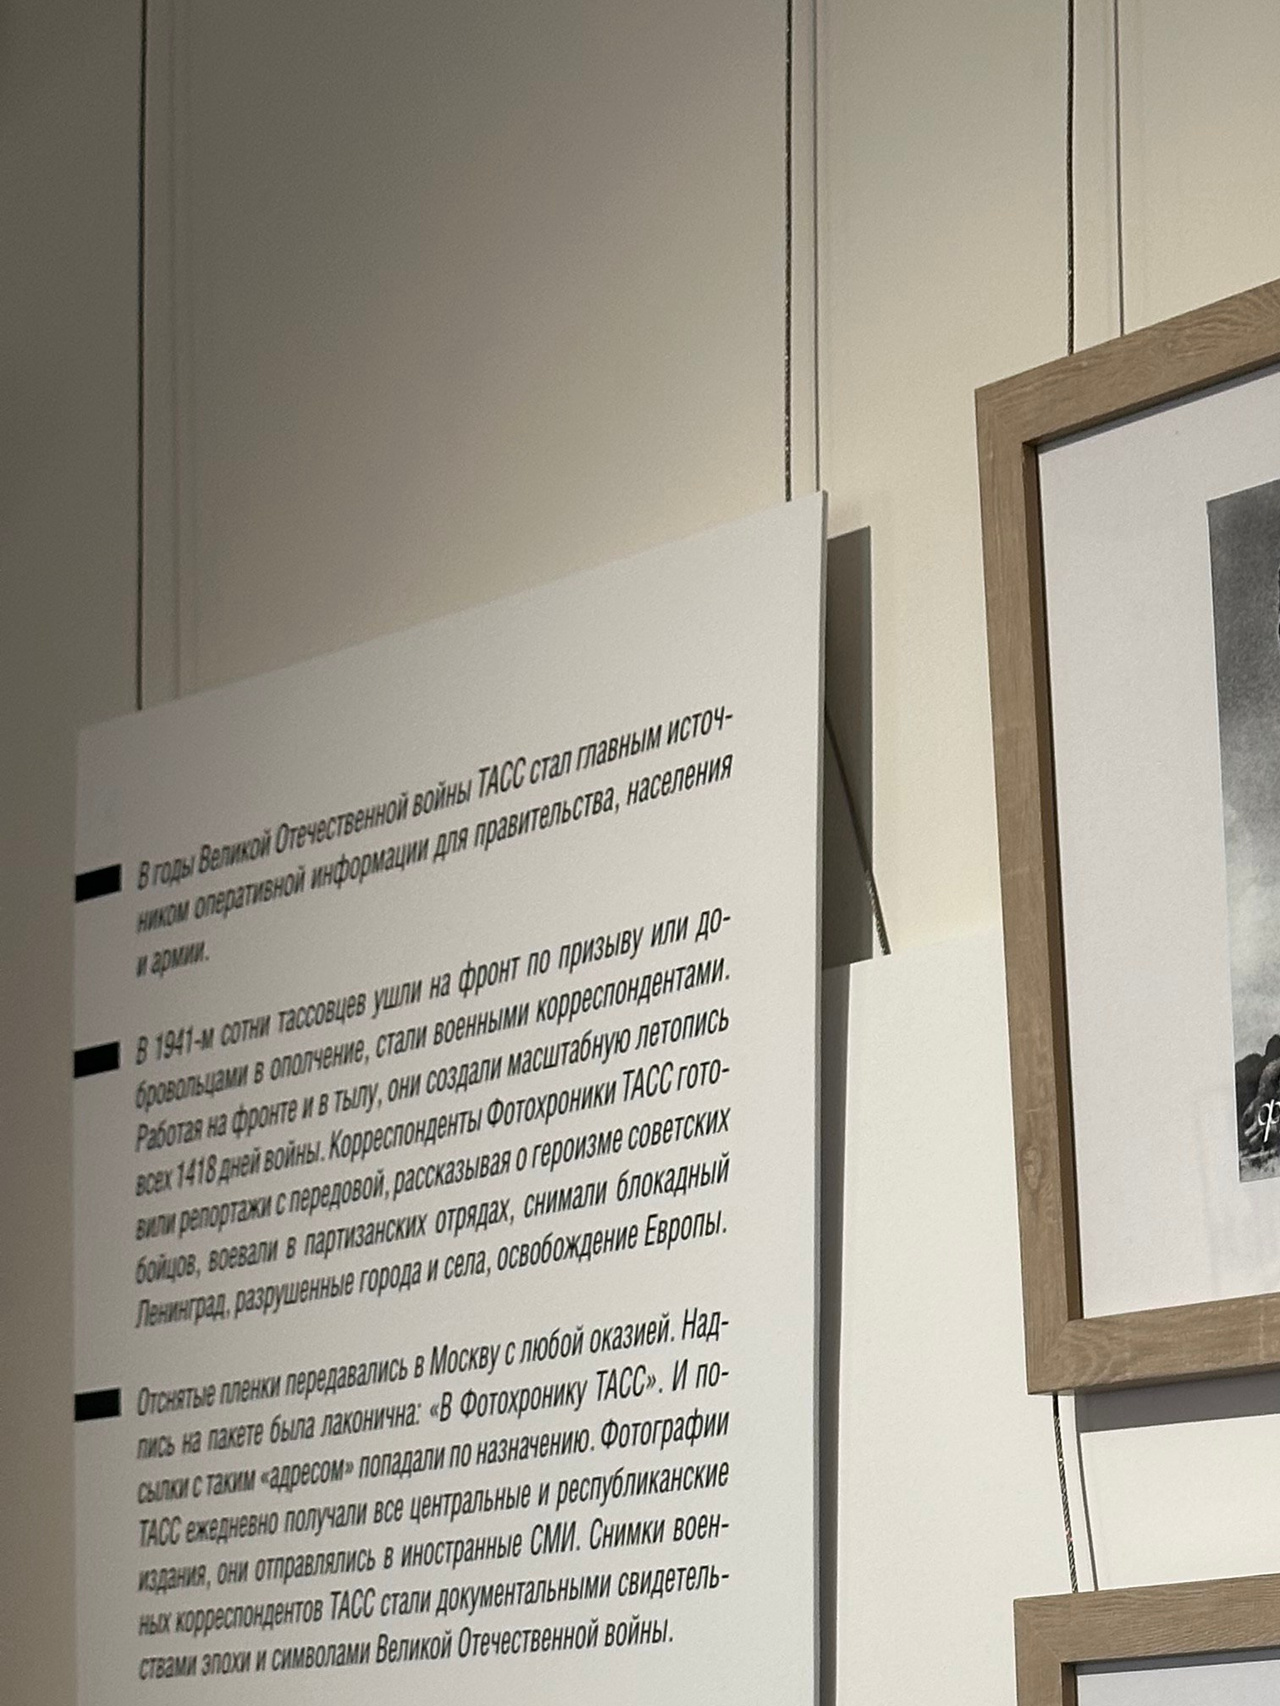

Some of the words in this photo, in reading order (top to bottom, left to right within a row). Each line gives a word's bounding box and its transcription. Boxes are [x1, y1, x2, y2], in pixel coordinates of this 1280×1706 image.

[137, 861, 149, 890] В
[153, 856, 194, 885] годы
[197, 829, 271, 874] Великой
[274, 791, 408, 854] Отечественной
[411, 778, 472, 817] войны
[477, 755, 526, 799] ТАСС
[528, 749, 572, 785] стал
[575, 723, 662, 772] главным
[665, 705, 733, 746] источ-
[137, 900, 189, 932] ником
[194, 865, 305, 919] оперативной
[310, 837, 429, 889] информации
[432, 826, 469, 863] для
[473, 786, 619, 851] правительства,
[625, 753, 733, 806] населения
[137, 954, 148, 978] и
[149, 939, 209, 978] армии.
[135, 1064, 248, 1112] бровольцами
[253, 1061, 264, 1084] в
[269, 1038, 369, 1081] ополчение,
[375, 1024, 427, 1058] стали
[432, 1001, 530, 1046] военными
[535, 956, 729, 1026] корреспондентами.
[136, 1253, 200, 1284] бойцов,
[208, 1239, 278, 1272] воевали
[285, 1236, 296, 1259] в
[303, 1213, 427, 1259] партизанских
[434, 1197, 514, 1238] отрядах,
[523, 1179, 608, 1219] снимали
[615, 1150, 730, 1202] блокадный
[140, 1515, 181, 1546] ТАСС
[185, 1511, 278, 1544] ежедневно
[283, 1502, 367, 1536] получали
[372, 1497, 404, 1523] все
[408, 1483, 531, 1525] центральные
[537, 1481, 550, 1506] и
[554, 1461, 729, 1512] республиканские
[138, 1612, 171, 1635] ных
[175, 1599, 323, 1637] корреспондентов
[330, 1586, 376, 1620] ТАСС
[379, 1589, 431, 1616] стали
[434, 1573, 612, 1617] документальными
[616, 1564, 729, 1600] свидетель-
[139, 1655, 197, 1680] ствами
[201, 1650, 251, 1676] эпохи
[255, 1649, 267, 1671] и
[270, 1641, 371, 1671] символами
[375, 1628, 452, 1663] Великой
[457, 1616, 599, 1658] Отечественной
[603, 1612, 673, 1647] войны.
